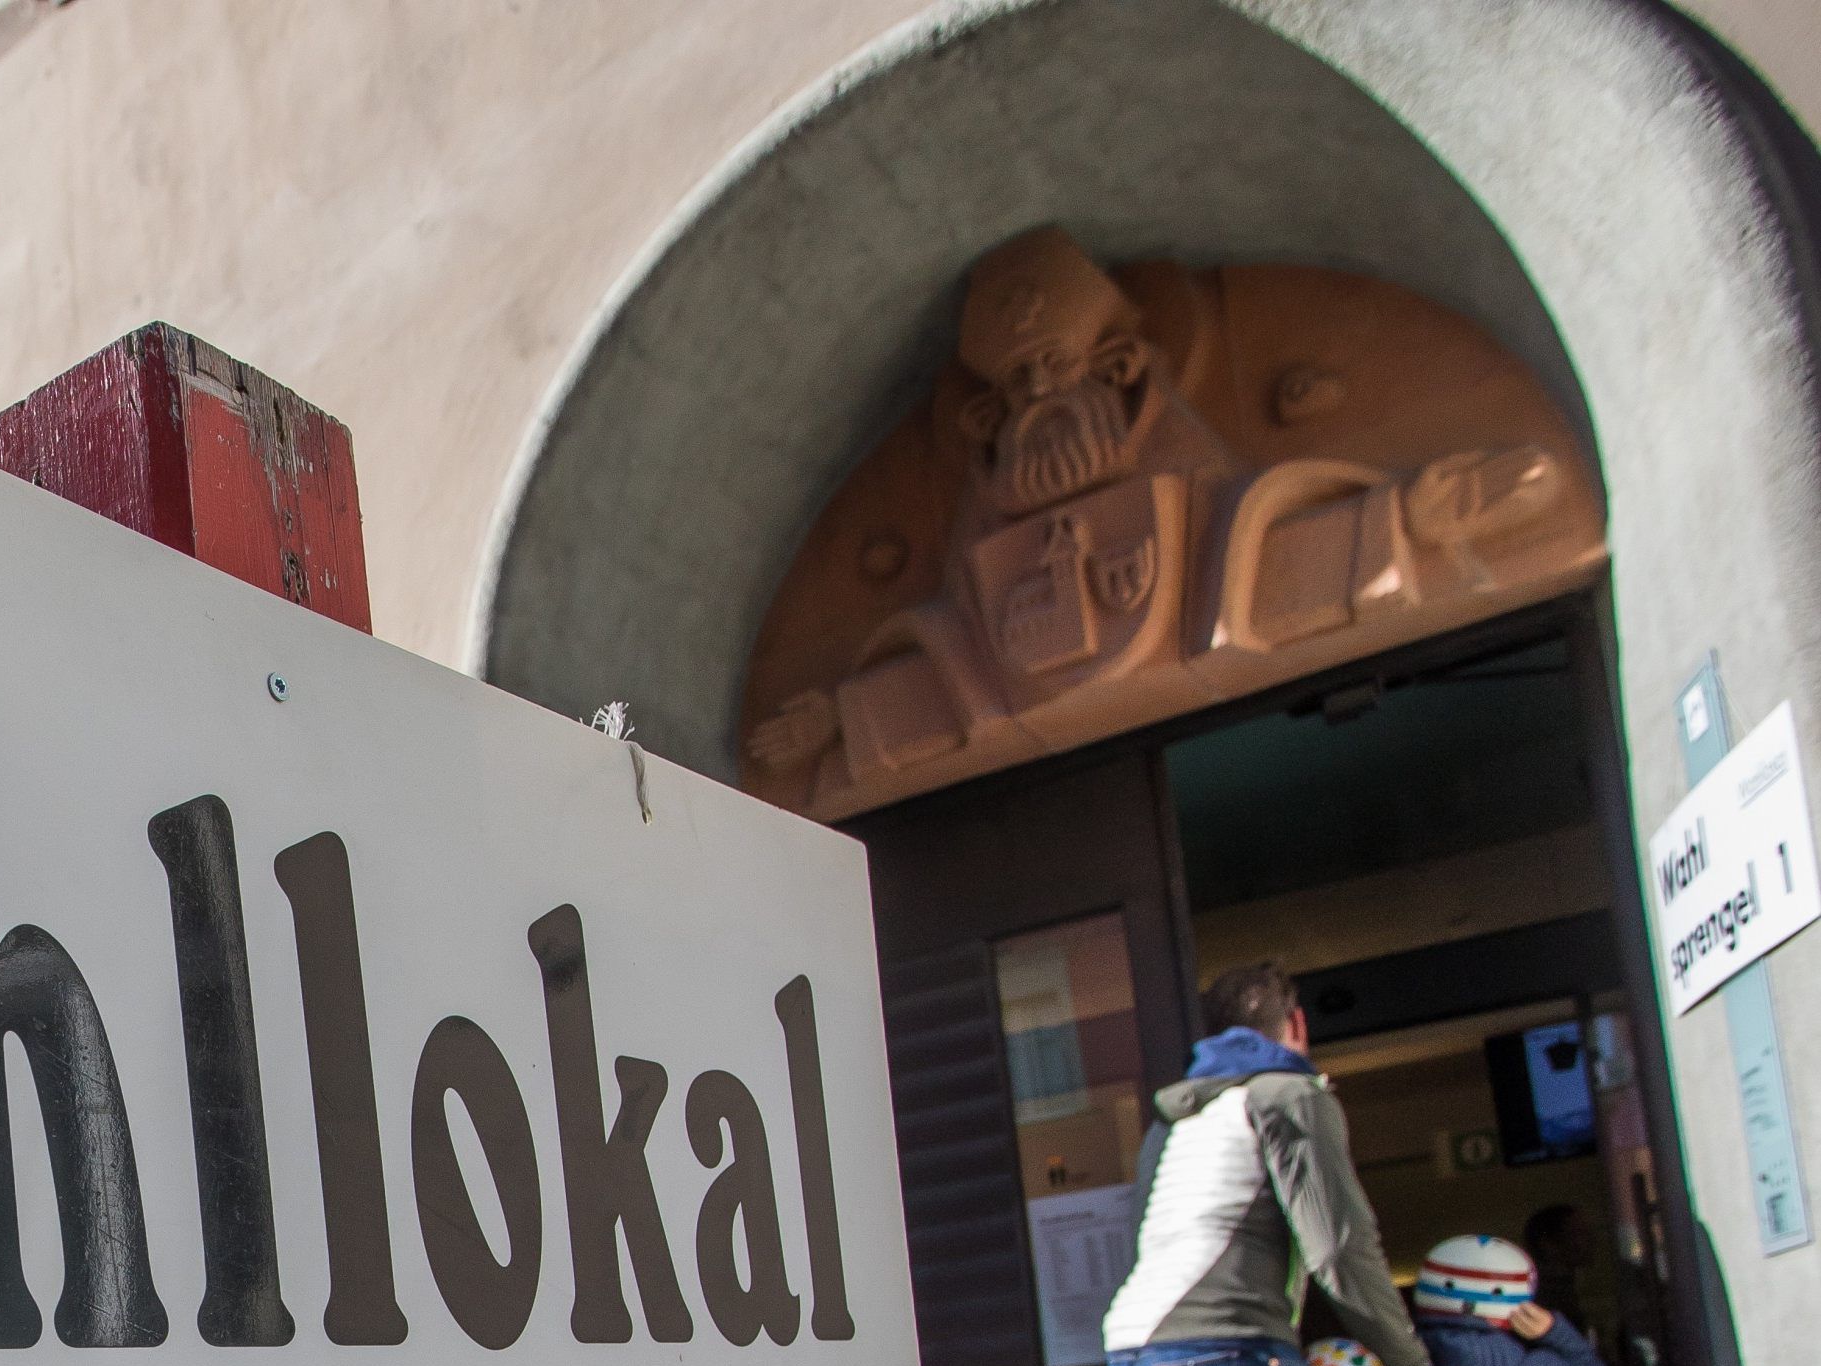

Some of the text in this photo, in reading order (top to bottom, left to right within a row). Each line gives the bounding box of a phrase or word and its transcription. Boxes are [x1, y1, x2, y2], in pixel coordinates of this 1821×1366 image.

[1658, 815, 1709, 906] Wahl
[1671, 840, 1793, 989] sprengel 1
